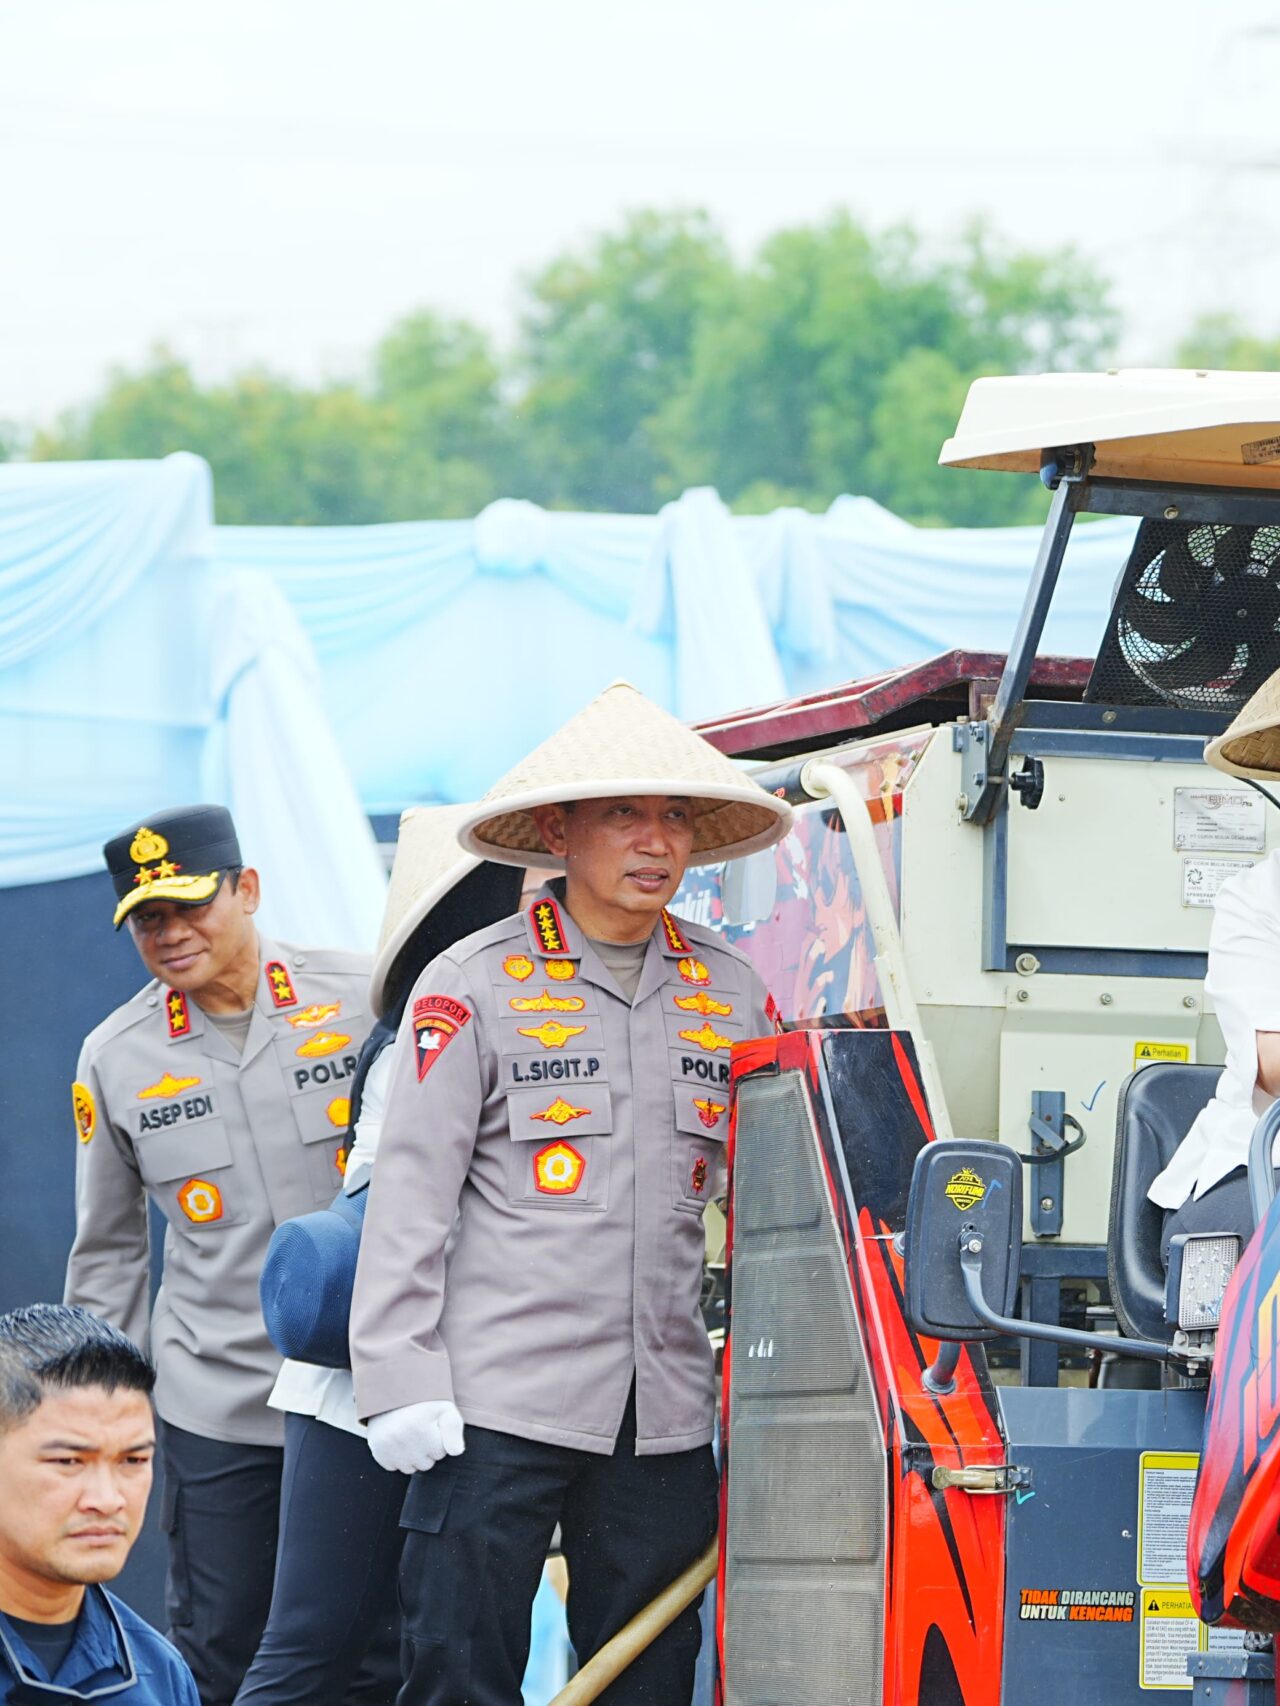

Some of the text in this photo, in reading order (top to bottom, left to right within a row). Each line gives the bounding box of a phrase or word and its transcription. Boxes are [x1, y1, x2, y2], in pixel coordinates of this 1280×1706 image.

[512, 1057, 600, 1082] L.SIGIT.P
[1021, 1589, 1134, 1606] TIDAK DIRANCANG
[1019, 1604, 1133, 1622] UNTUK KENCANG
